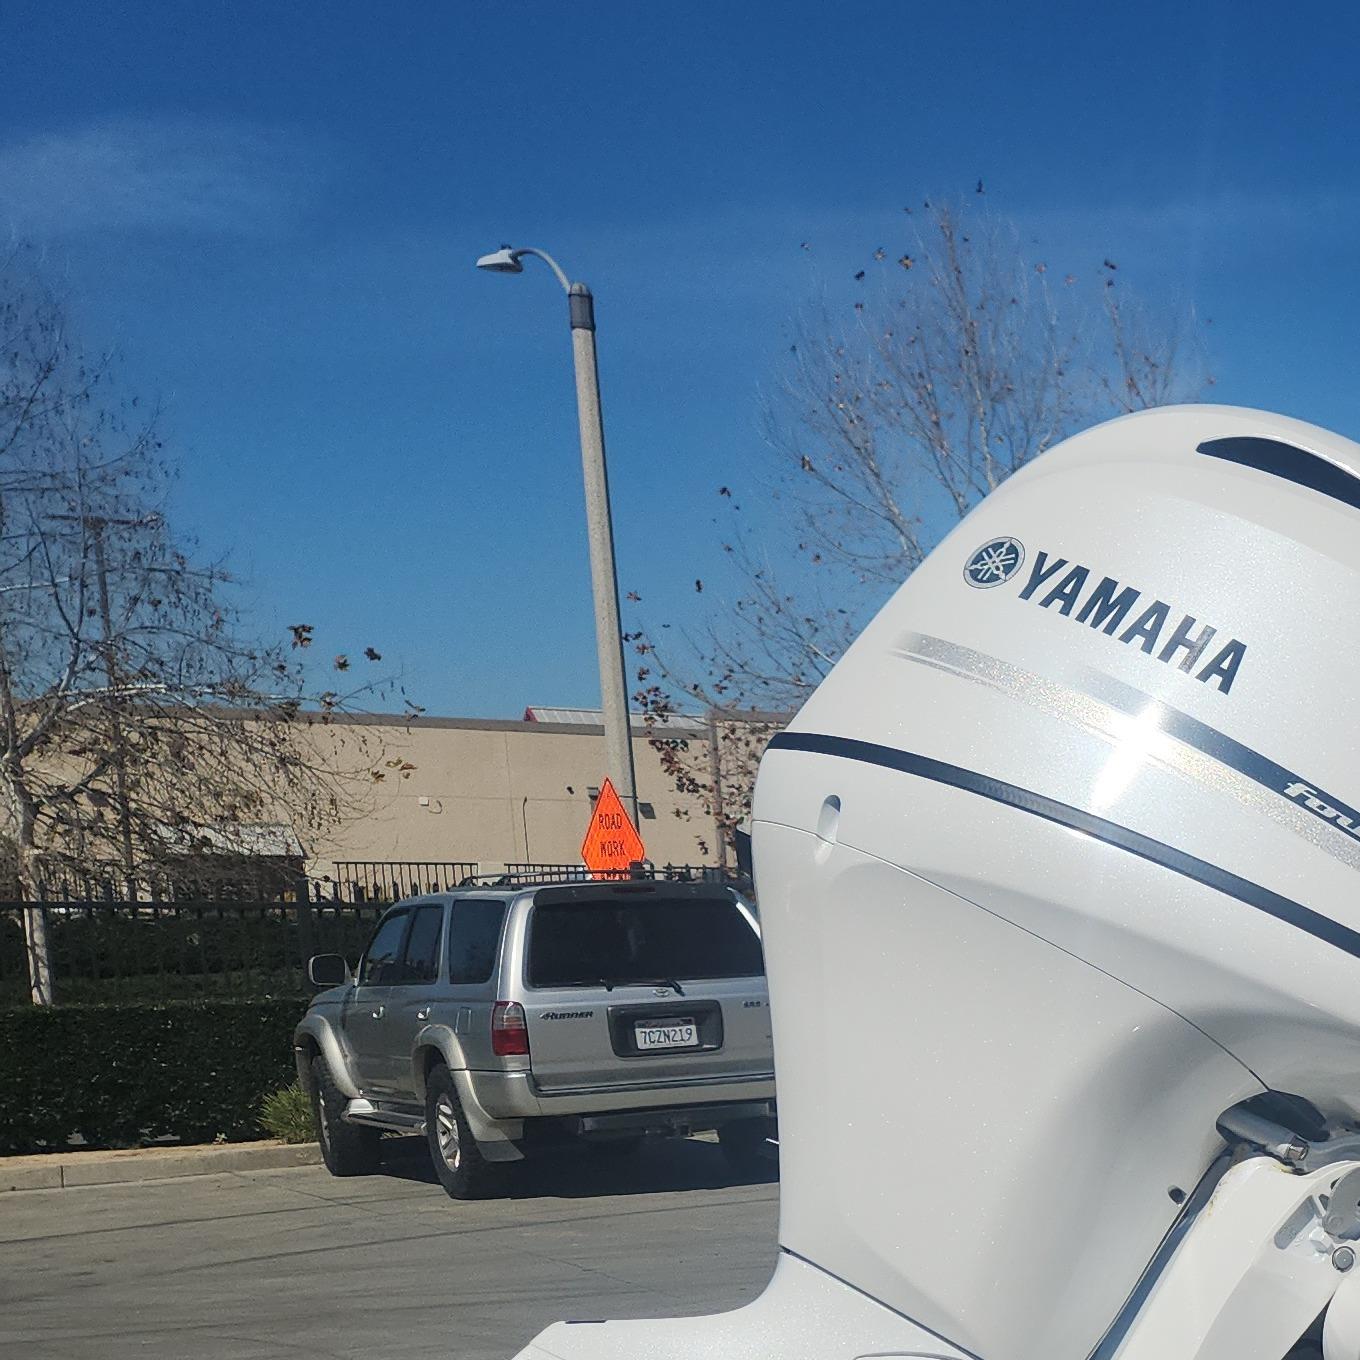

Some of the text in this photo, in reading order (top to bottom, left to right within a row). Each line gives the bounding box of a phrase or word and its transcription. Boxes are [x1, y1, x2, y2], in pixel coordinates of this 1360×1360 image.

[1018, 550, 1247, 694] YAMAHA
[599, 813, 623, 830] ROAD
[600, 840, 625, 857] WORK
[640, 1028, 693, 1045] 7CZN219
